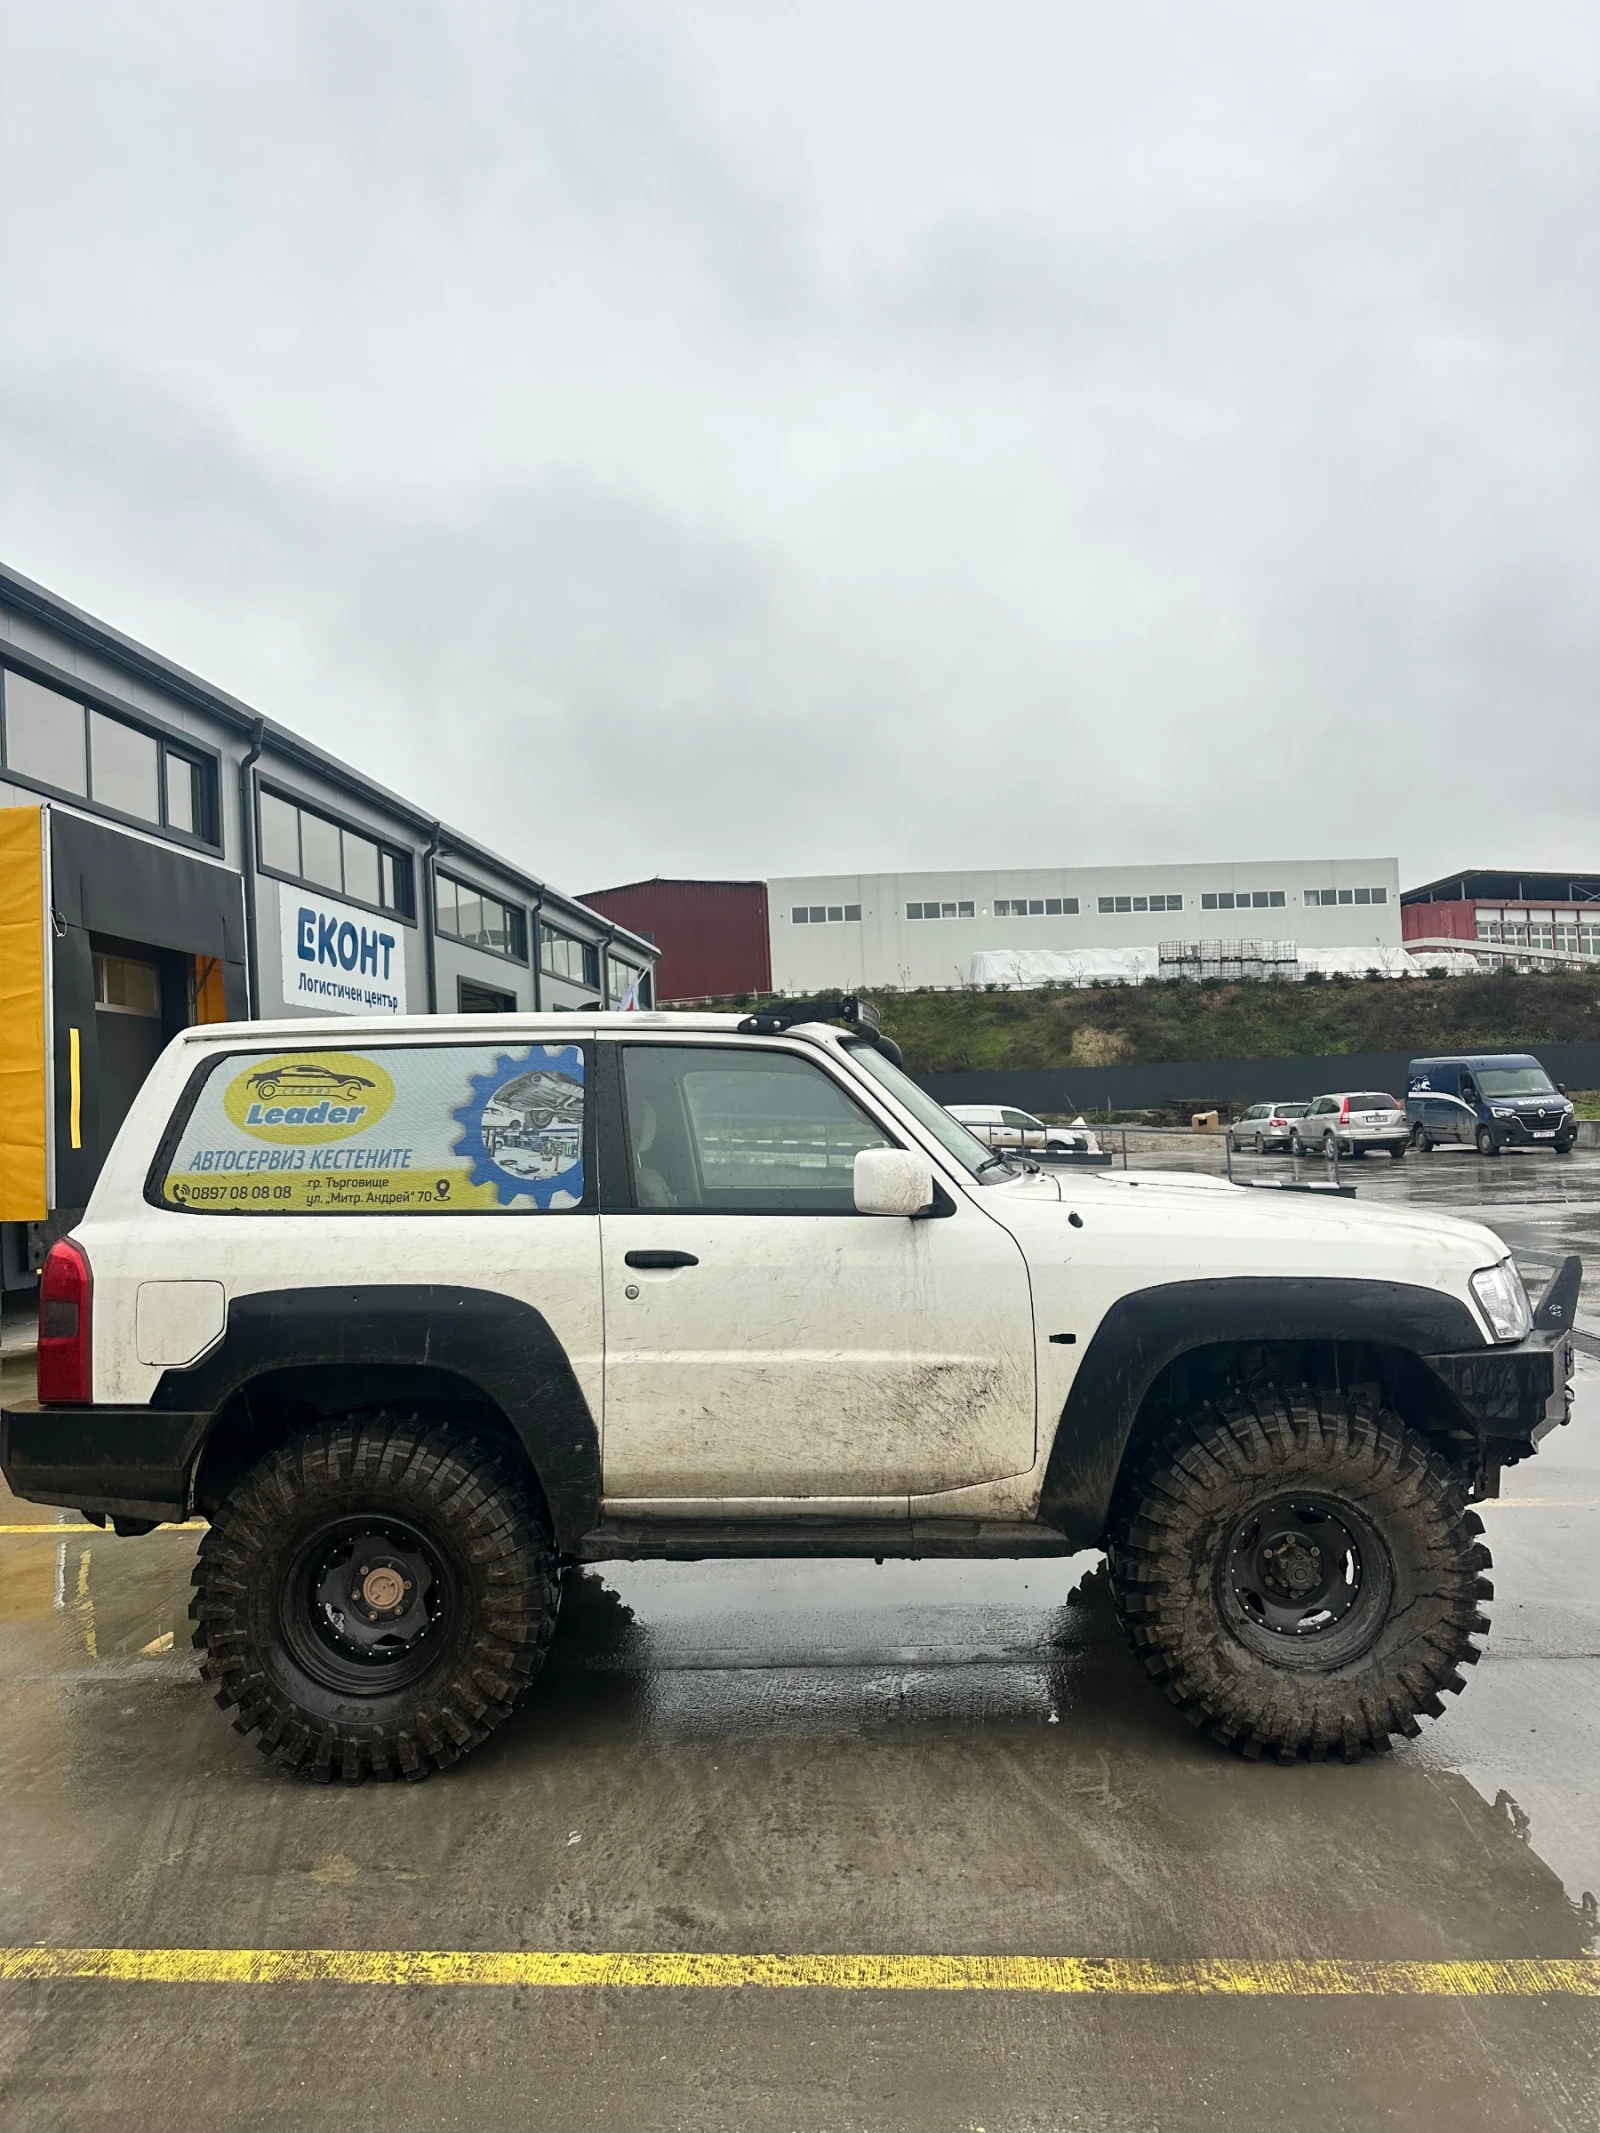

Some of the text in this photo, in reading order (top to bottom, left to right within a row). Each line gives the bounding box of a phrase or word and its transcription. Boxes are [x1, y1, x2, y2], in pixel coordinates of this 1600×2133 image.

[297, 907, 396, 981] ЕКОНТ
[298, 972, 398, 1014] Логистичен център
[282, 1087, 332, 1095] СЕРВИЗ
[246, 1101, 366, 1125] Leader
[188, 1148, 413, 1171] АВТОСЕРВИЗ КЕСТЕНИТЕ
[191, 1185, 291, 1200] 0897 08 08 08
[307, 1177, 389, 1191] гр. Търговище
[306, 1194, 323, 1207] ул.
[417, 1190, 432, 1203] 70
